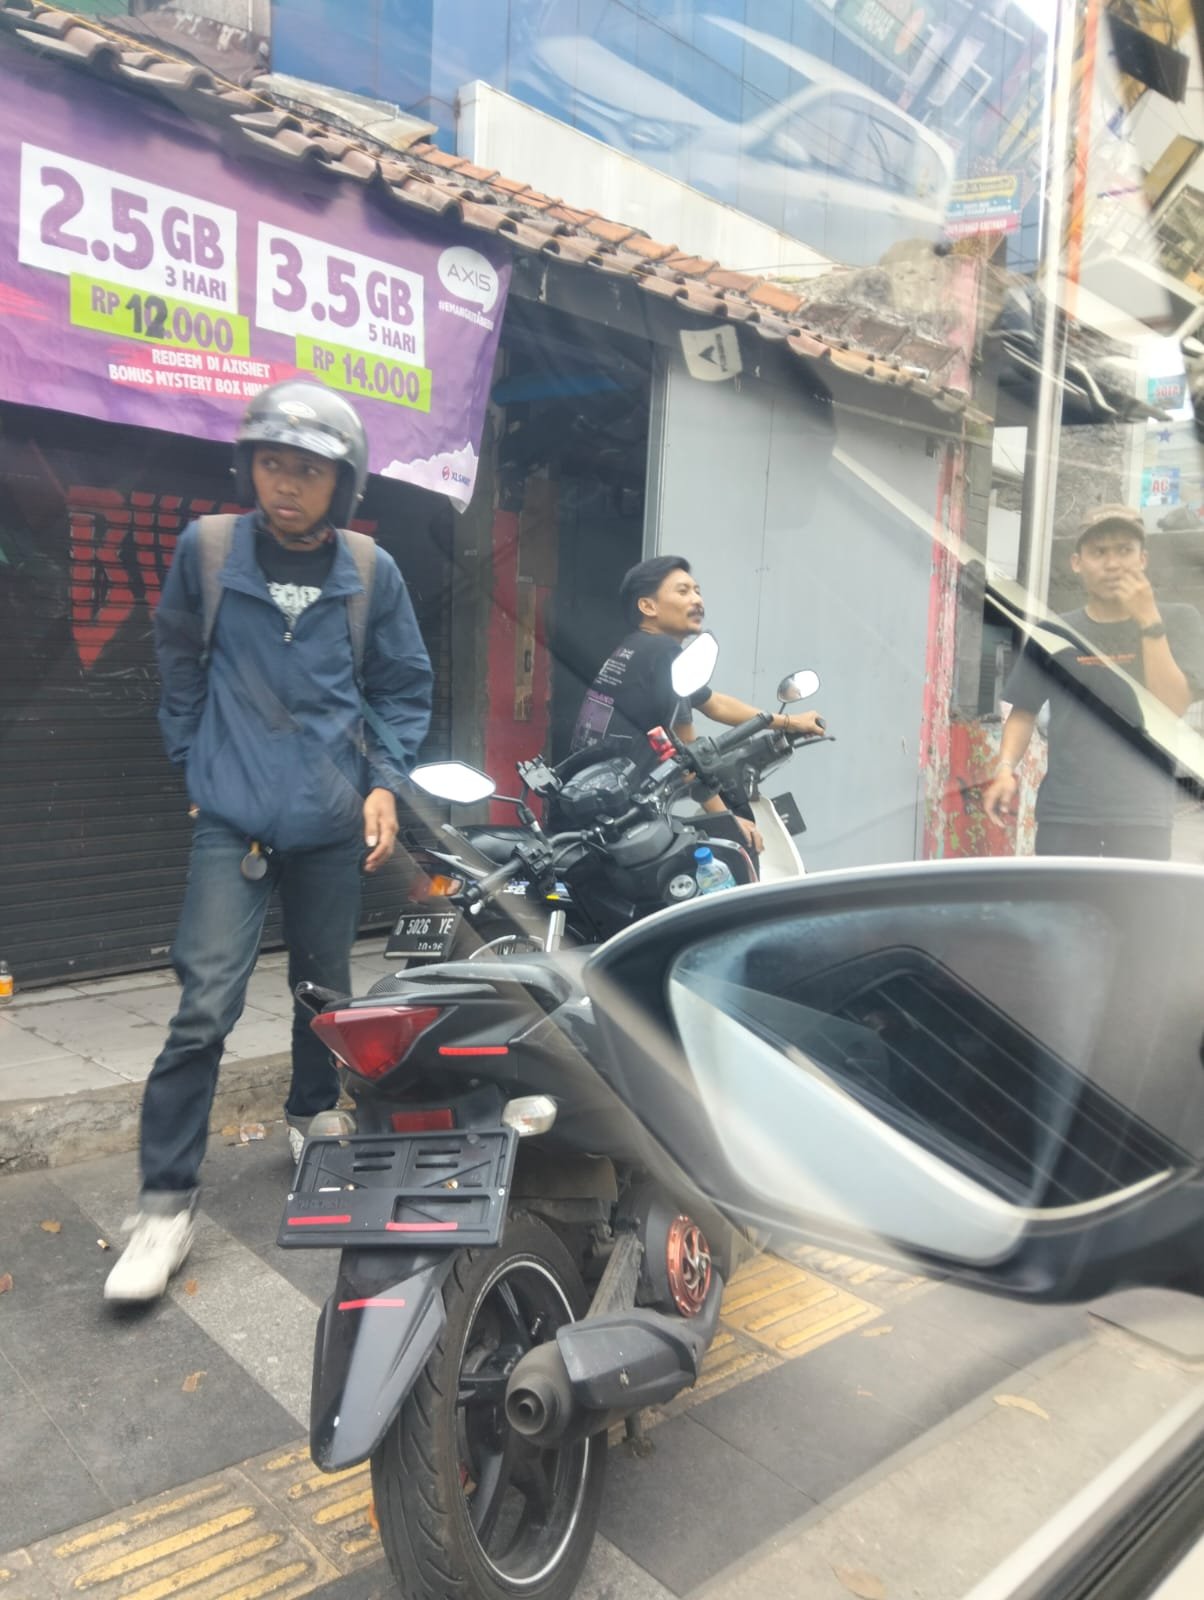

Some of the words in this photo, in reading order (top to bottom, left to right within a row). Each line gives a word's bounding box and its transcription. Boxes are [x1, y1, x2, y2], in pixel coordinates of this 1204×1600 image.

[40, 166, 154, 270] 2.5
[161, 206, 225, 270] GB
[165, 265, 177, 287] 3
[182, 270, 227, 301] HARI
[270, 237, 361, 328] 3.5
[366, 270, 414, 326] GB
[447, 263, 491, 292] AXIS
[91, 285, 120, 315] RP
[368, 323, 377, 342] 5
[382, 326, 416, 354] HARI
[108, 363, 154, 384] BONUS
[156, 370, 213, 392] MYSTERY
[215, 378, 241, 395] BOX
[151, 349, 203, 369] REDEEM
[207, 355, 221, 371] DI
[223, 358, 271, 378] AXISNET
[312, 345, 335, 371] RP
[342, 353, 420, 403] 14.000
[406, 918, 432, 936] 5026
[438, 917, 455, 936] YE
